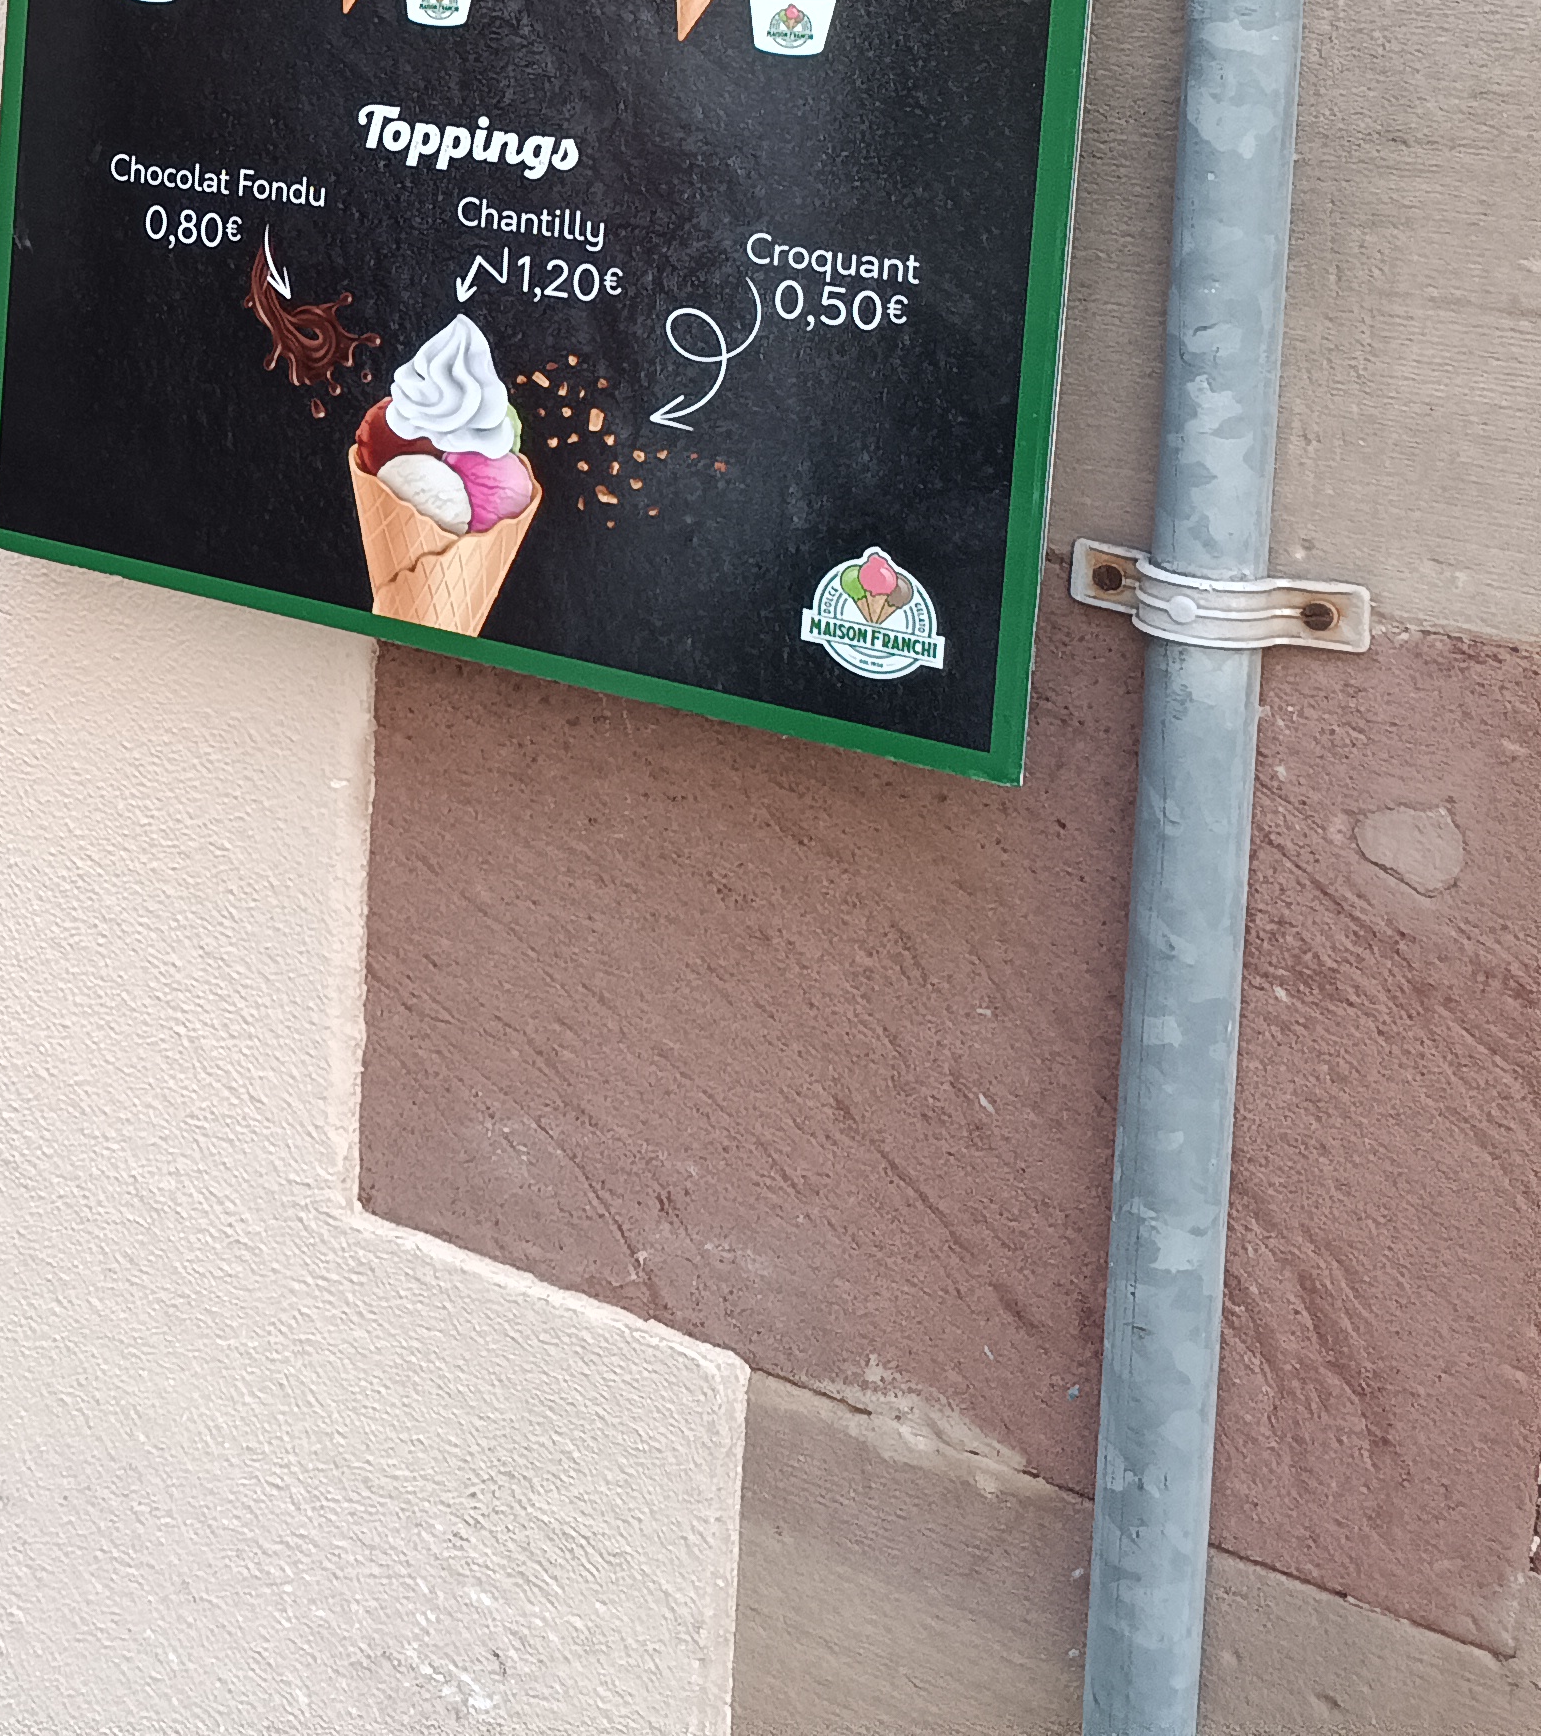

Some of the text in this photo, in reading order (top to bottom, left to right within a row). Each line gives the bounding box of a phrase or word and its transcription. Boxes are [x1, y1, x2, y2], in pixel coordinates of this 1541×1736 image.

[358, 105, 579, 179] Toppings
[111, 154, 325, 207] Chocolat Fondu
[146, 205, 242, 248] 0,80€
[458, 197, 604, 251] Chantilly
[518, 256, 623, 302] 1,20€
[747, 233, 920, 284] Croquant
[775, 280, 908, 331] 0,50€
[809, 616, 938, 659] MAISON FRANCHI
